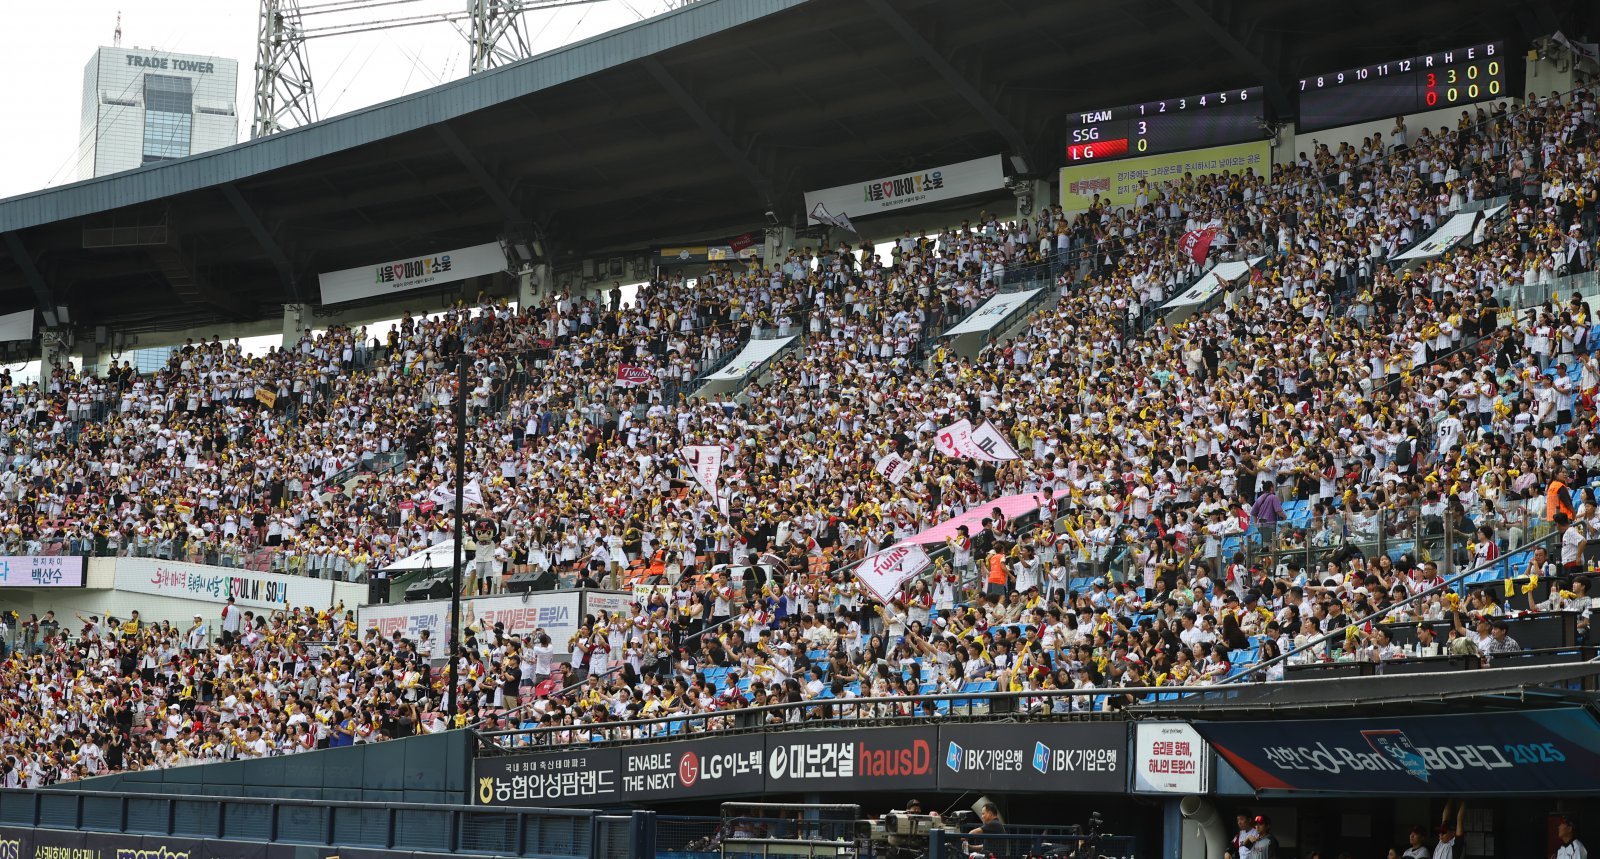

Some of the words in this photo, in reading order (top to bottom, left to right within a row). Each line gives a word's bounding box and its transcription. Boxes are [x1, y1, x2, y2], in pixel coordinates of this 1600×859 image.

[126, 55, 168, 69] TRADE
[172, 59, 213, 73] TOWER
[1300, 80, 1306, 91] 7
[1317, 77, 1324, 87] 8
[1337, 73, 1344, 84] 9
[1355, 68, 1368, 80] 10
[1377, 64, 1388, 76] 11
[1398, 60, 1411, 72] 12
[1426, 56, 1433, 67] R
[1445, 52, 1453, 63] H
[1468, 48, 1475, 59] E
[1487, 44, 1494, 55] B
[1427, 73, 1436, 88] 3
[1447, 69, 1456, 84] 3
[1467, 65, 1477, 80] 0
[1488, 61, 1499, 76] 0
[1426, 91, 1437, 106] 0
[1447, 88, 1457, 102] 0
[1468, 84, 1479, 98] 0
[1489, 80, 1500, 94] 0
[1081, 110, 1112, 124] TEAM
[1139, 105, 1145, 115] 1
[1159, 102, 1166, 113] 2
[1179, 99, 1186, 109] 3
[1199, 96, 1206, 107] 4
[1220, 93, 1227, 103] 5
[1240, 90, 1247, 100] 6
[1073, 128, 1099, 142] SSG
[1138, 121, 1146, 135] 3
[1137, 138, 1147, 152] 0
[1151, 164, 1183, 177] 그라운드를
[1185, 159, 1217, 173] 주시하시고
[1219, 156, 1245, 168] 날아오는
[622, 366, 650, 379] Twin
[1441, 426, 1451, 436] 51
[874, 547, 909, 576] TWINS
[32, 568, 62, 585] 백산수
[266, 581, 287, 603] SOUL
[538, 606, 569, 628] 트윈스
[1153, 741, 1173, 756] 승리를
[1262, 746, 1310, 770] 신한
[1504, 743, 1566, 763] 2025
[505, 763, 520, 773] 국내
[522, 761, 537, 771] 최대
[628, 753, 672, 772] ENABLE
[789, 742, 854, 779] 대보건설
[1149, 759, 1169, 774] 하나의
[1171, 760, 1195, 774] 트윈스!
[495, 769, 615, 802] 농협안성팜랜드
[623, 774, 646, 792] THE
[647, 772, 677, 791] NEXT
[0, 838, 19, 859] os
